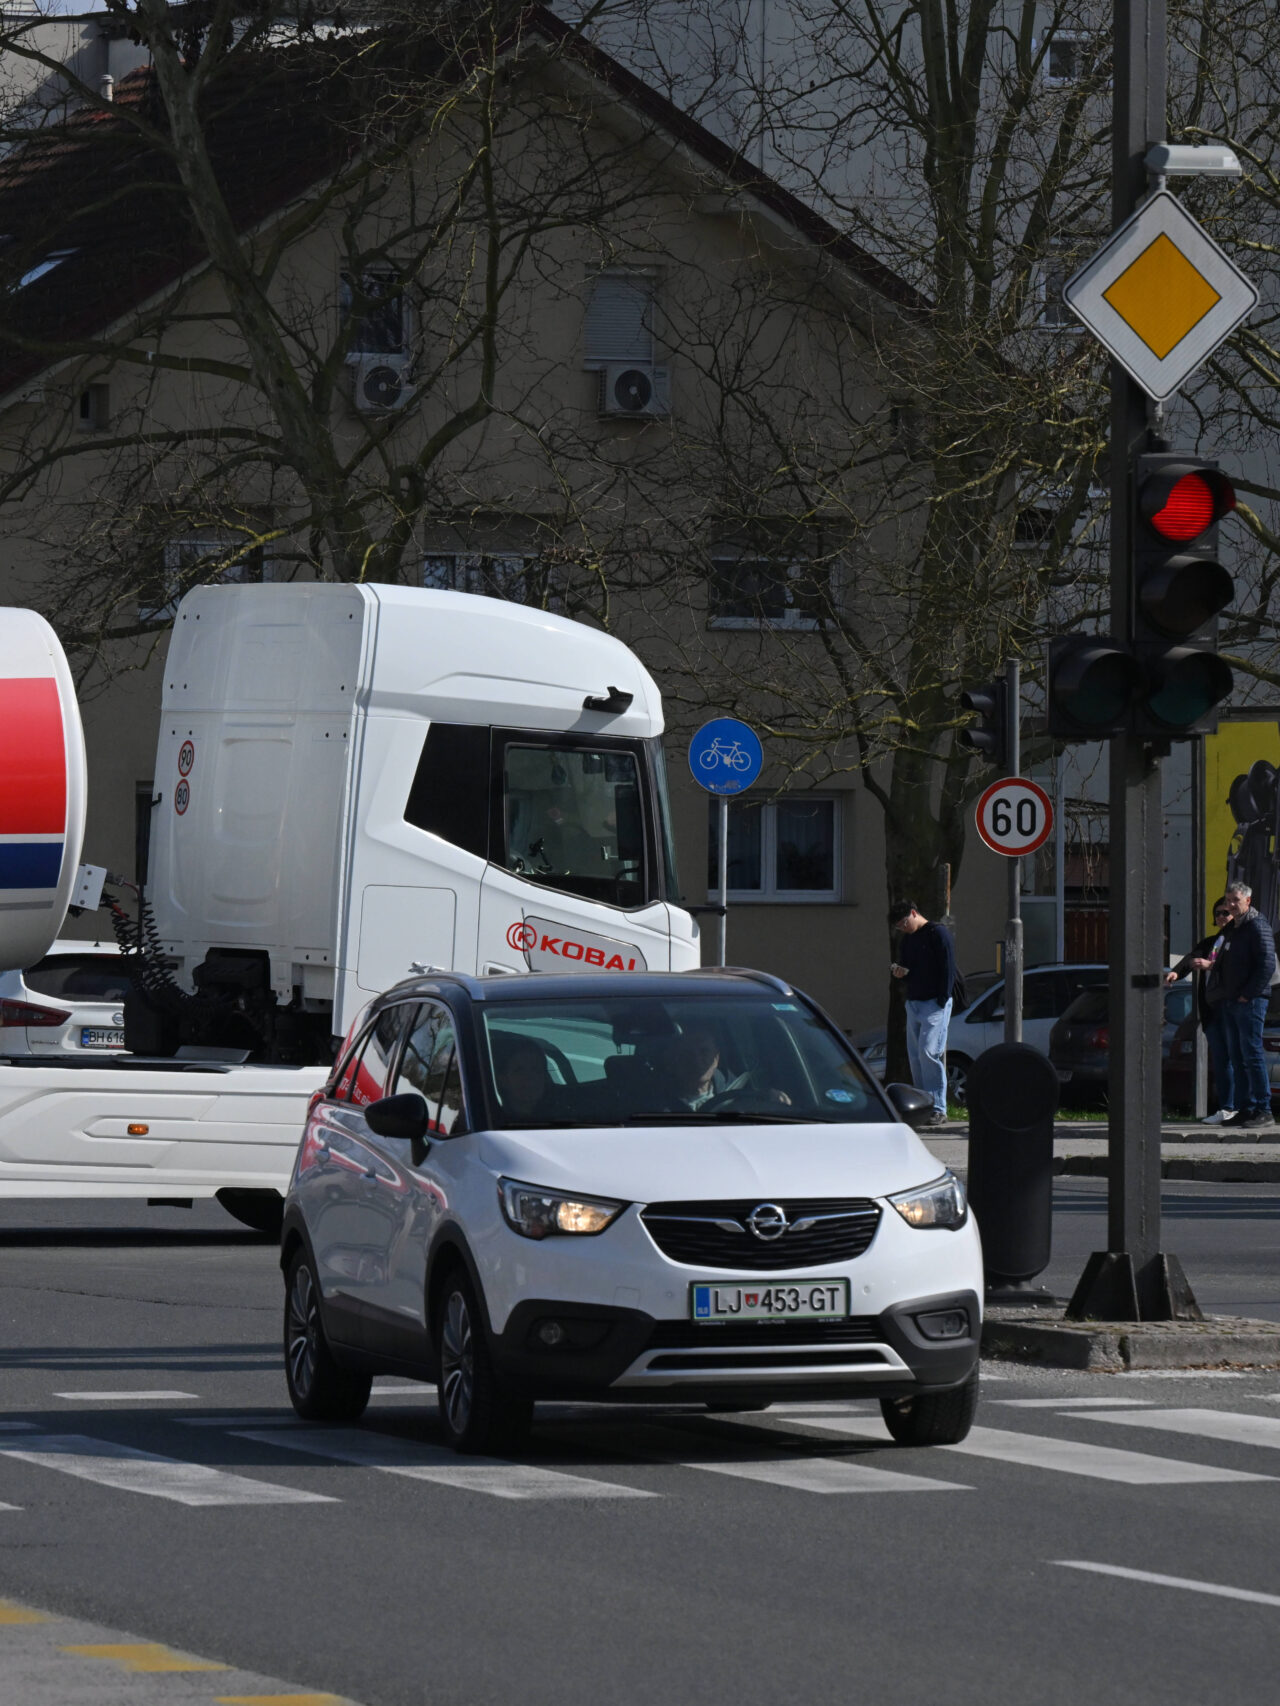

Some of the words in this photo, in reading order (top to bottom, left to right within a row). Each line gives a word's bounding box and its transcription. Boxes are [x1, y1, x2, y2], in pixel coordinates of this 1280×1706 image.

[181, 749, 192, 767] 90
[176, 788, 188, 805] 80
[992, 798, 1036, 836] 60
[89, 1031, 105, 1043] BH
[715, 1289, 742, 1314] LJ
[761, 1288, 840, 1313] 453-GT
